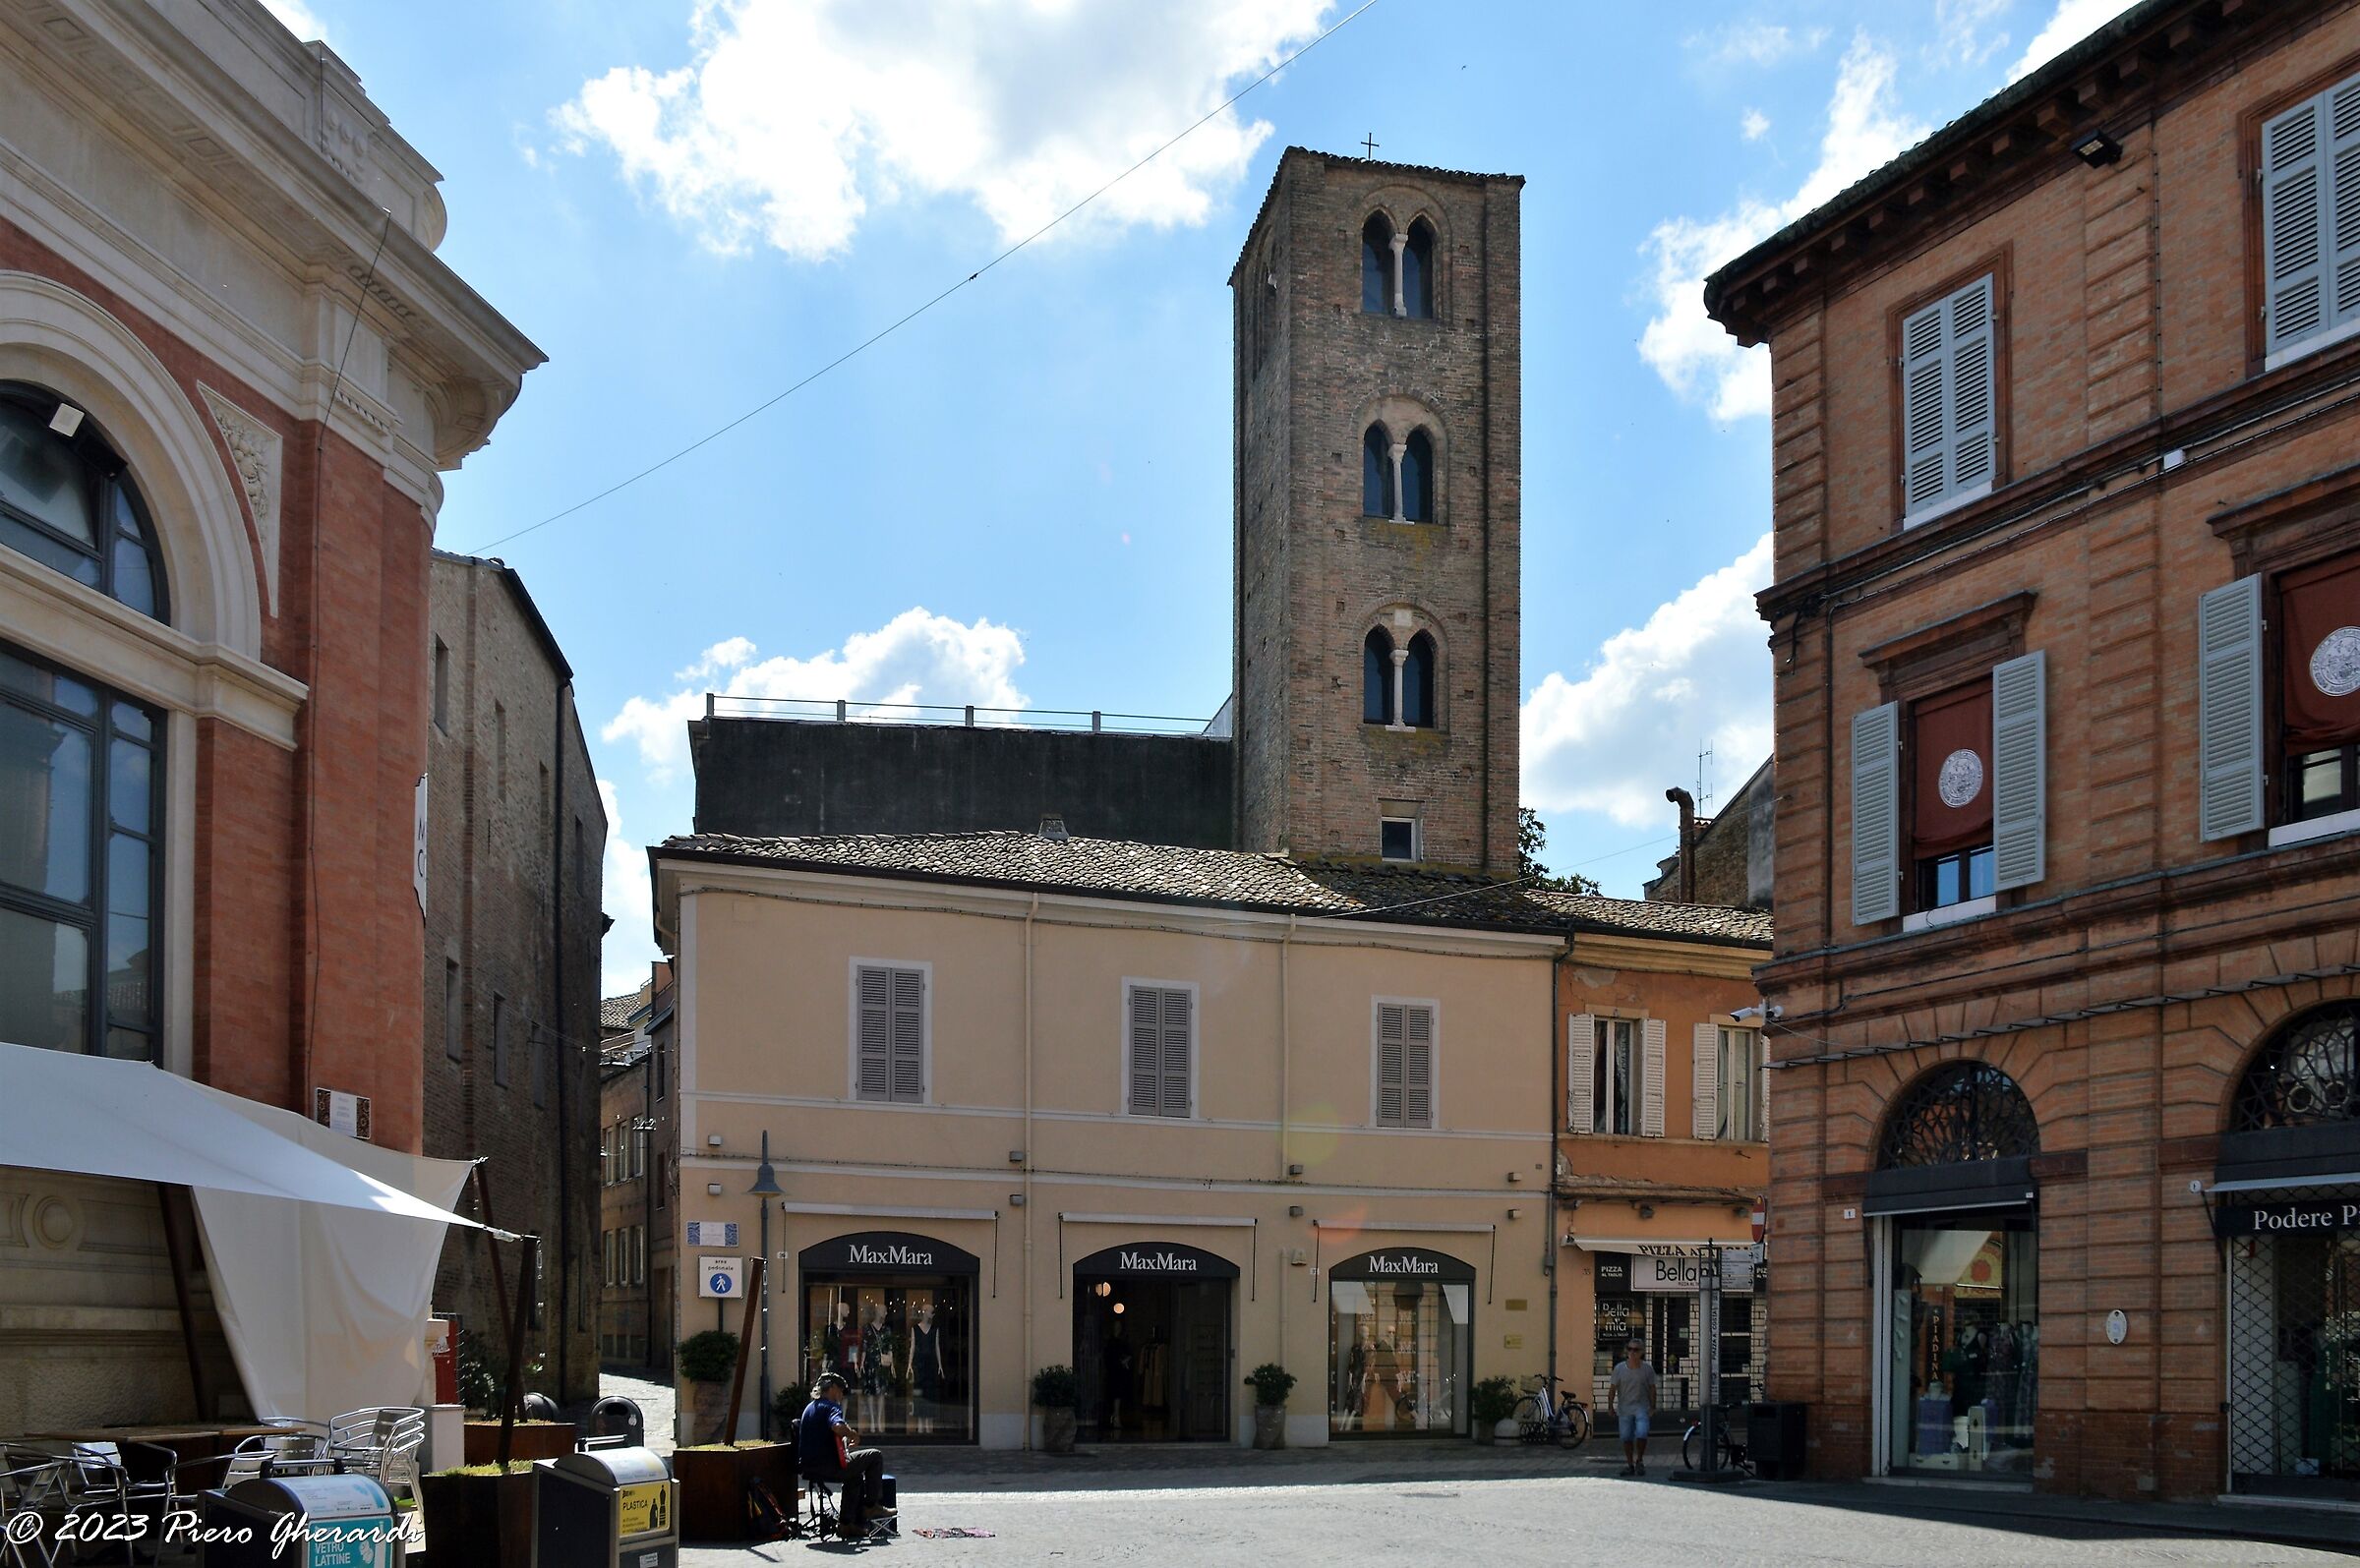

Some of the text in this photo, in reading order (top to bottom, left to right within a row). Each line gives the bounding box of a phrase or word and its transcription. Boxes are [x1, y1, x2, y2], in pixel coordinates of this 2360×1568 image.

[2253, 1204, 2360, 1230] Podere P
[848, 1244, 933, 1265] MaxMara
[1637, 1245, 1686, 1256] PIZZA
[1119, 1251, 1198, 1271] MaxMara
[1368, 1255, 1439, 1274] MaxMara
[1655, 1258, 1698, 1281] Bella
[622, 1499, 648, 1511] PLASTICA
[315, 1542, 344, 1554] VETRO
[315, 1553, 351, 1567] LATTINE
